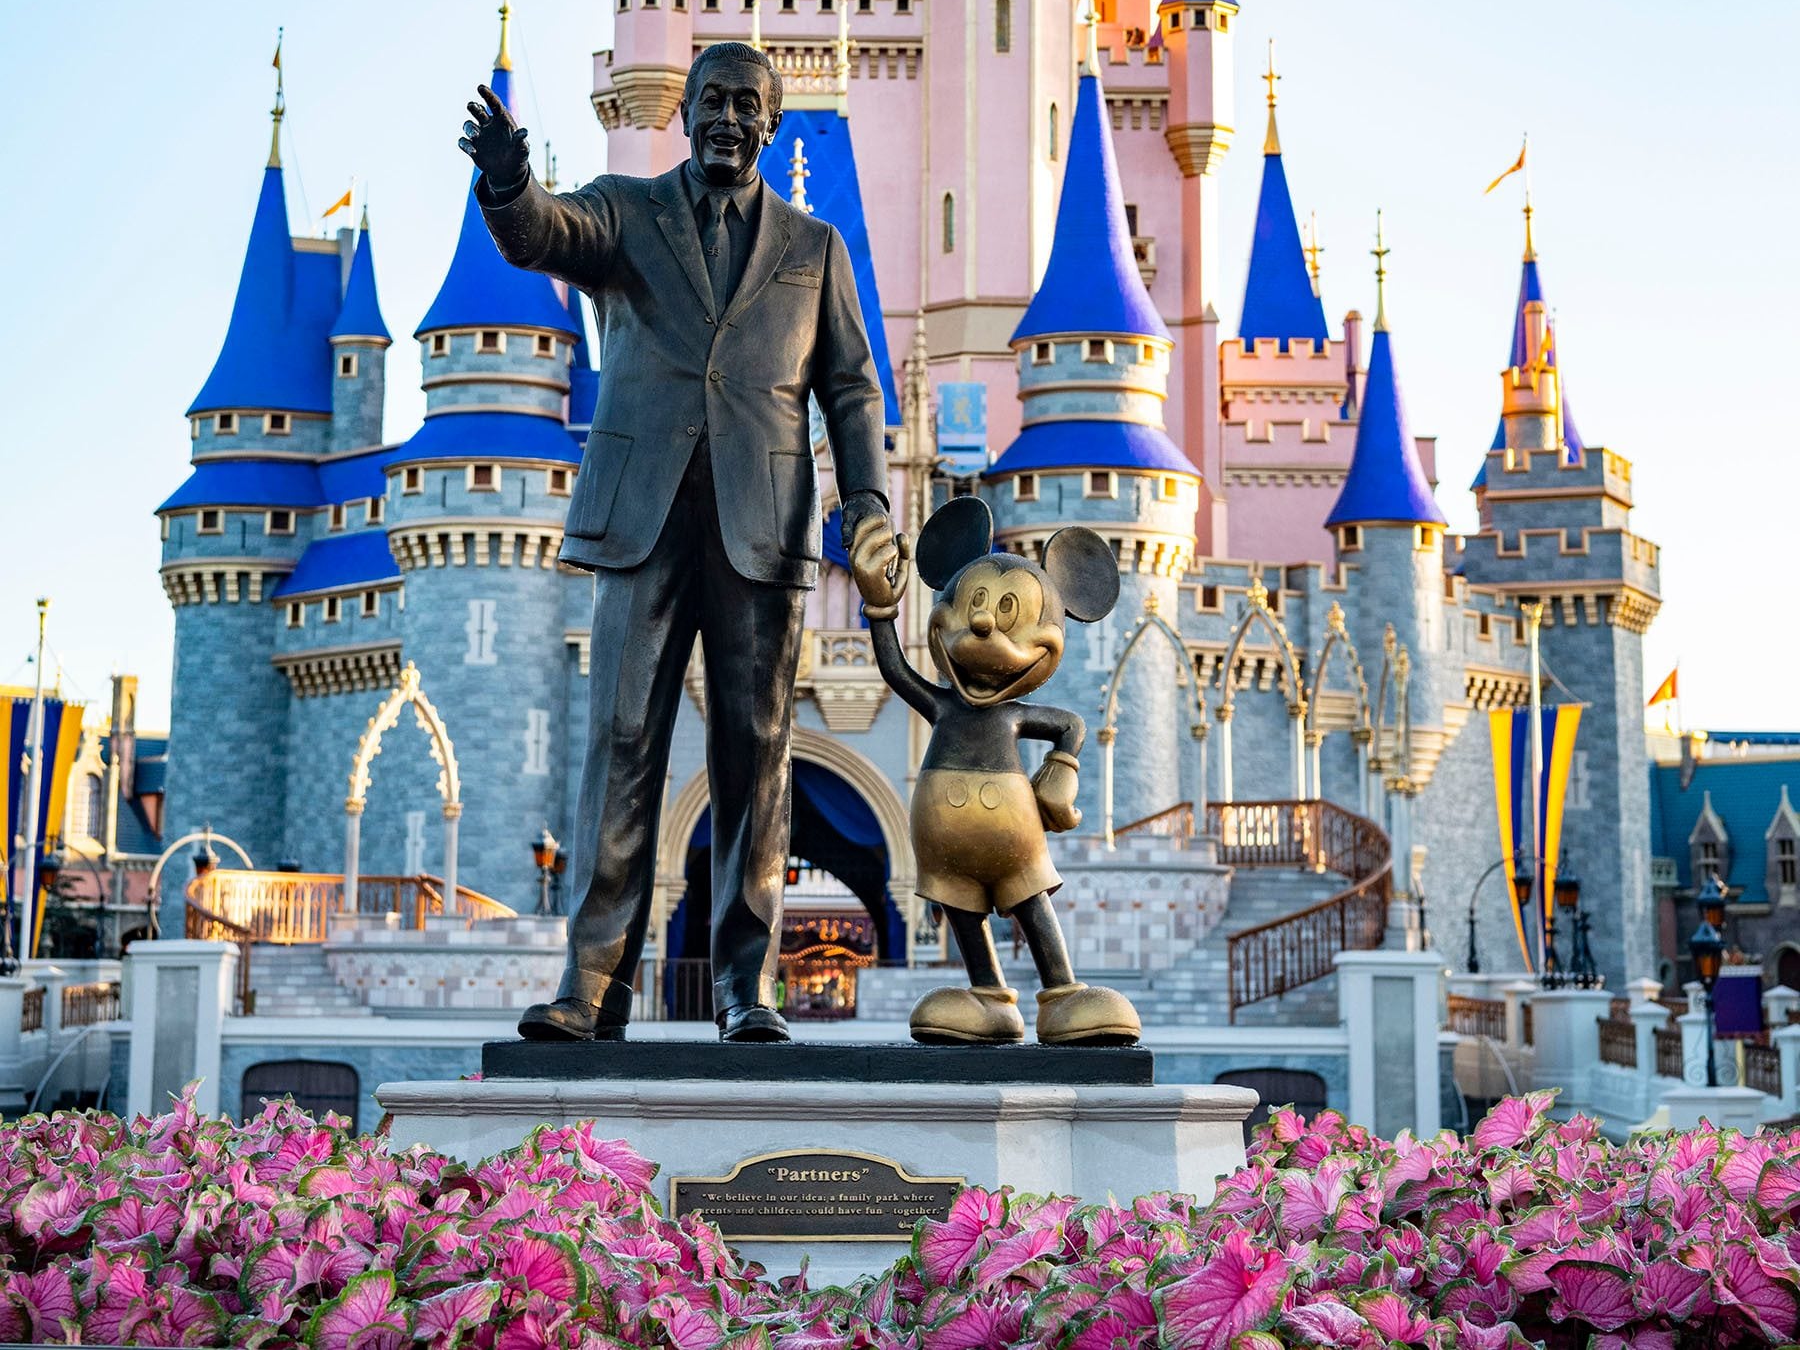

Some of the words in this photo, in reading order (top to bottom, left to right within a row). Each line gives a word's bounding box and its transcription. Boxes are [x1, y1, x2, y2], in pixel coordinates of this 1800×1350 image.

[767, 1167, 870, 1182] “Partners”
[726, 1193, 763, 1202] believe
[766, 1193, 776, 1202] in
[839, 1193, 872, 1204] family
[876, 1193, 899, 1204] park
[903, 1193, 935, 1202] where
[735, 1206, 754, 1215] and
[758, 1206, 803, 1215] children
[805, 1206, 835, 1215] could
[838, 1206, 862, 1215] have
[865, 1206, 883, 1215] fun
